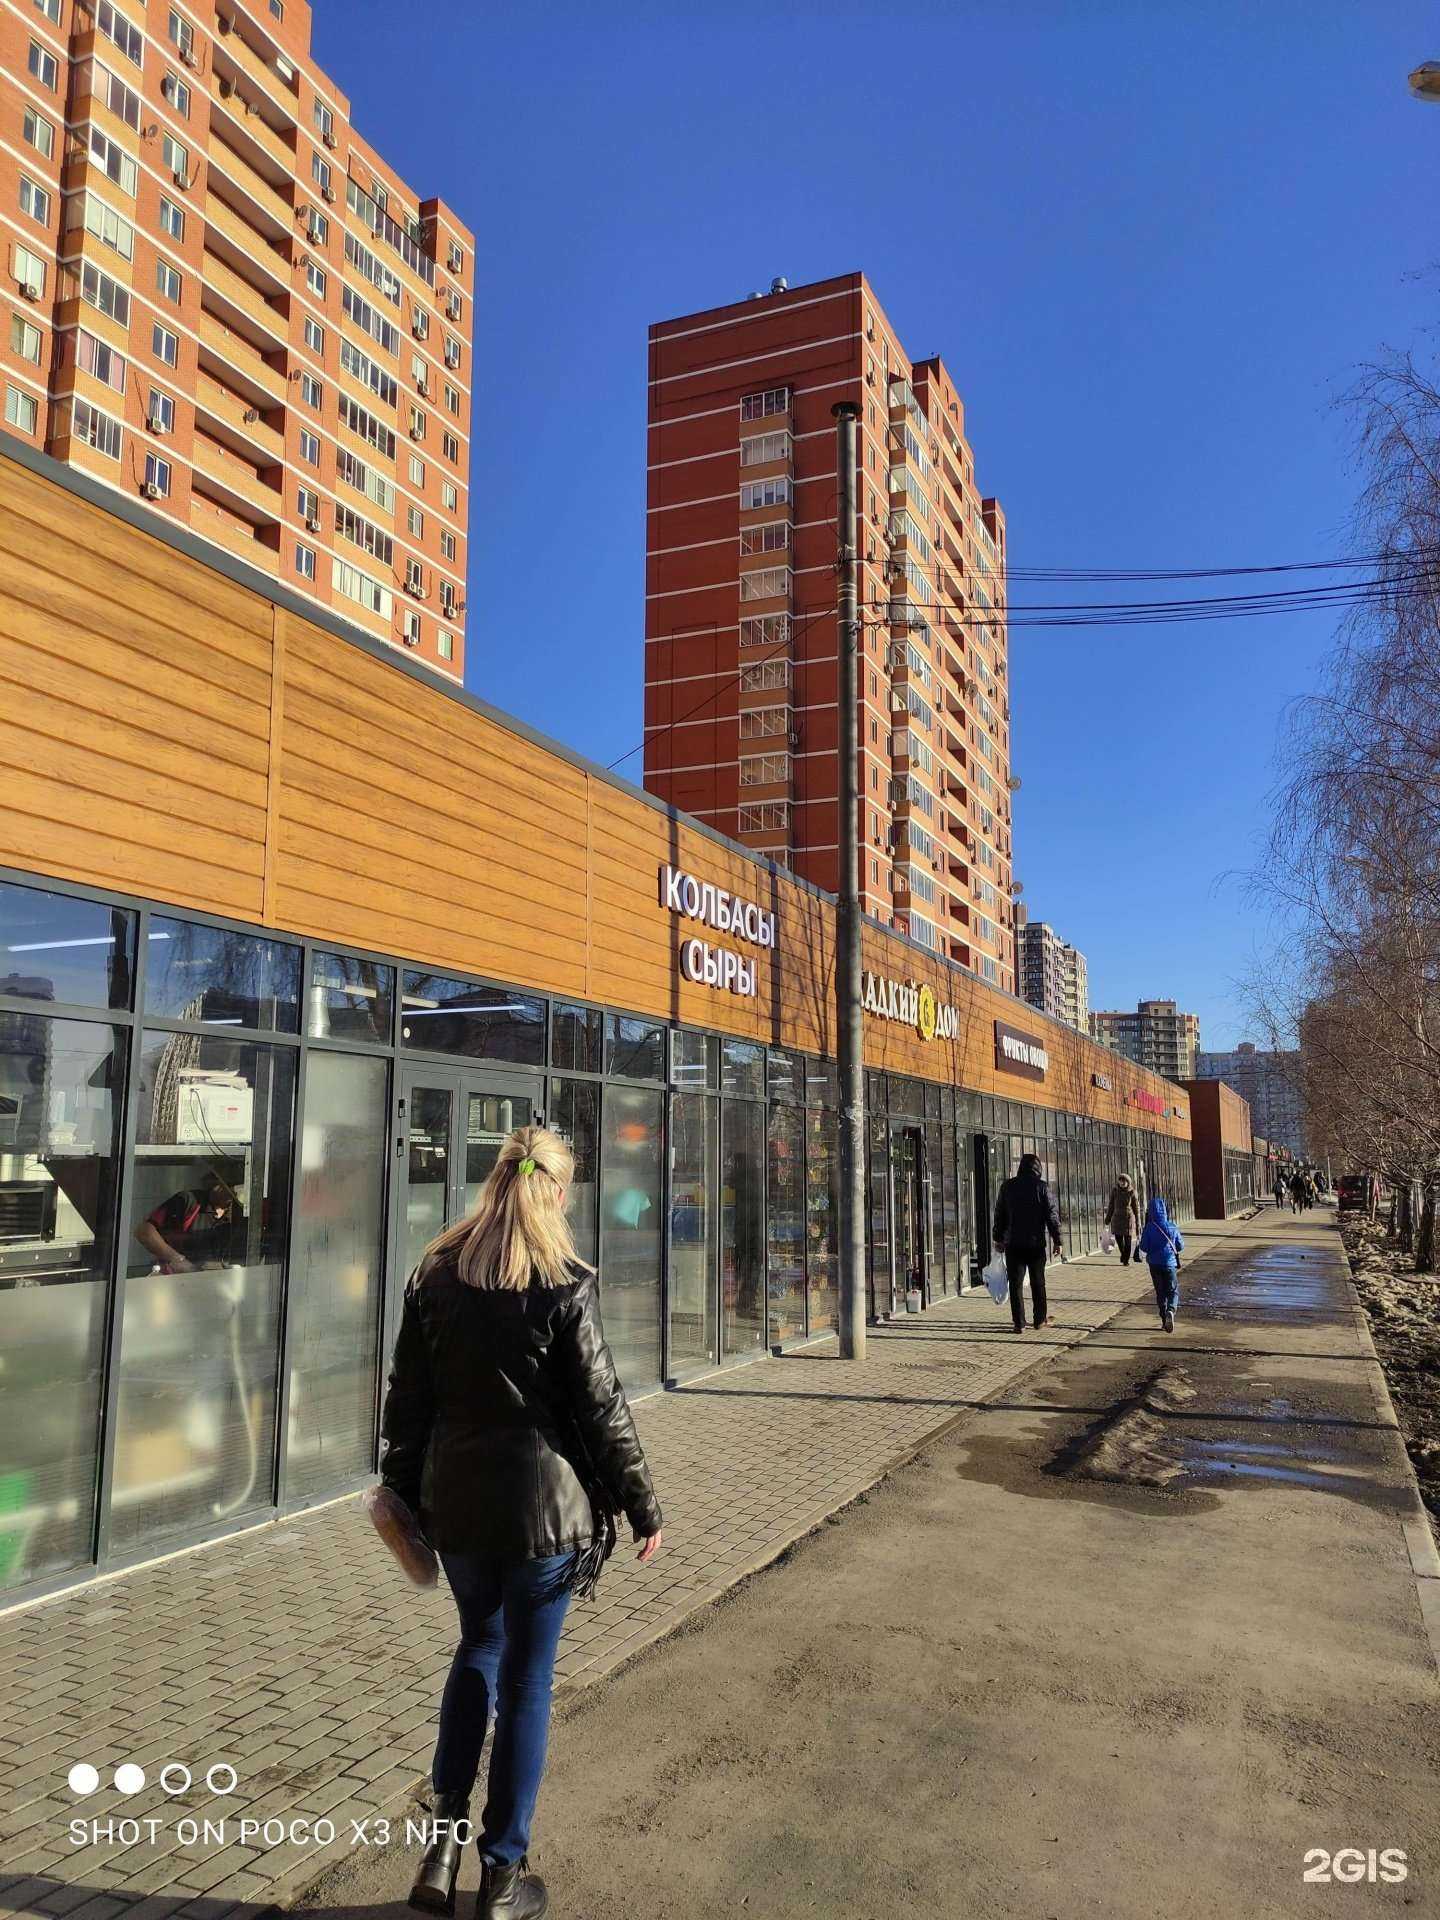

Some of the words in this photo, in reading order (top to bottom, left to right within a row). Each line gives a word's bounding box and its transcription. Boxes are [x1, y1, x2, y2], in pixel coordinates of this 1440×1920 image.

[663, 865, 775, 948] КОЛБАСЫ
[685, 939, 755, 997] СЫРЫ
[935, 1002, 960, 1040] ДОМ
[1002, 1035, 1029, 1065] ФРУКТЫ
